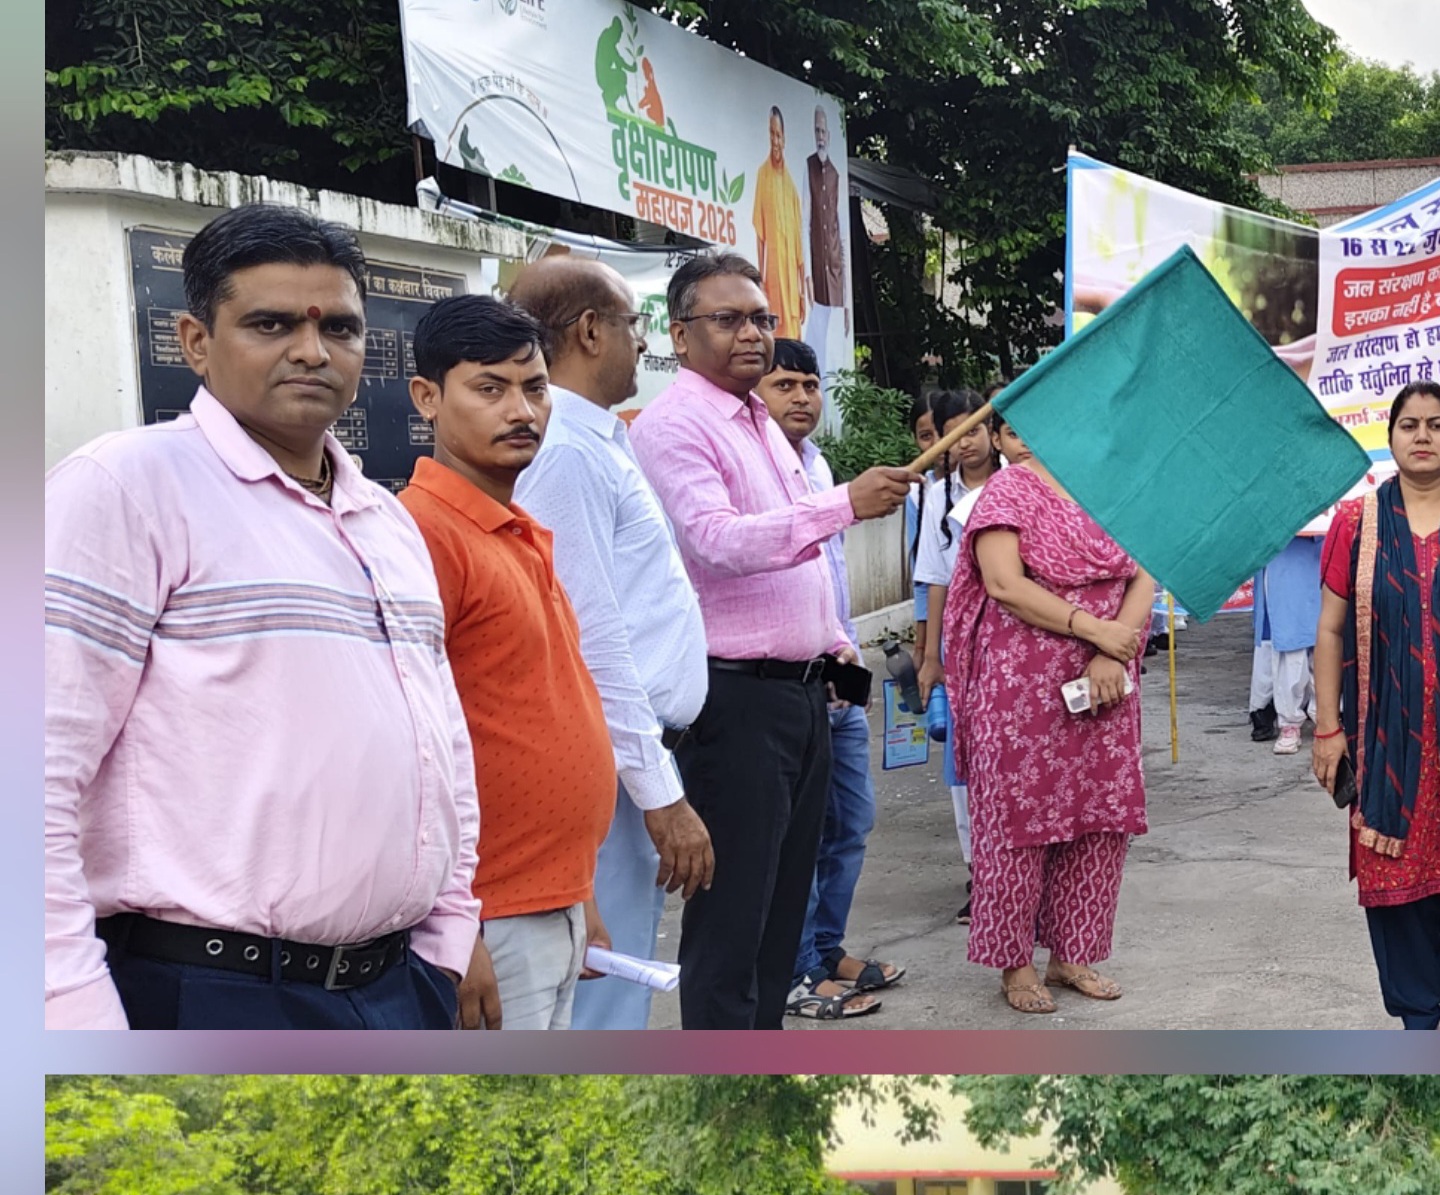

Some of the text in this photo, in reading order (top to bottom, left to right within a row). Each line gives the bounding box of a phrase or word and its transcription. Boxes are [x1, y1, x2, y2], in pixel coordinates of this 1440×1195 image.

[607, 112, 717, 202] वृक्षारोपण
[697, 200, 736, 246] 2026
[1340, 238, 1363, 256] 16
[1343, 280, 1375, 298] जल
[1344, 306, 1390, 330] इसका
[1420, 290, 1432, 315] है
[1326, 343, 1352, 363] जल
[1404, 327, 1420, 349] हो
[1318, 368, 1354, 396] ताकि
[1358, 361, 1411, 396] संतुलित
[1416, 355, 1433, 380] रहे
